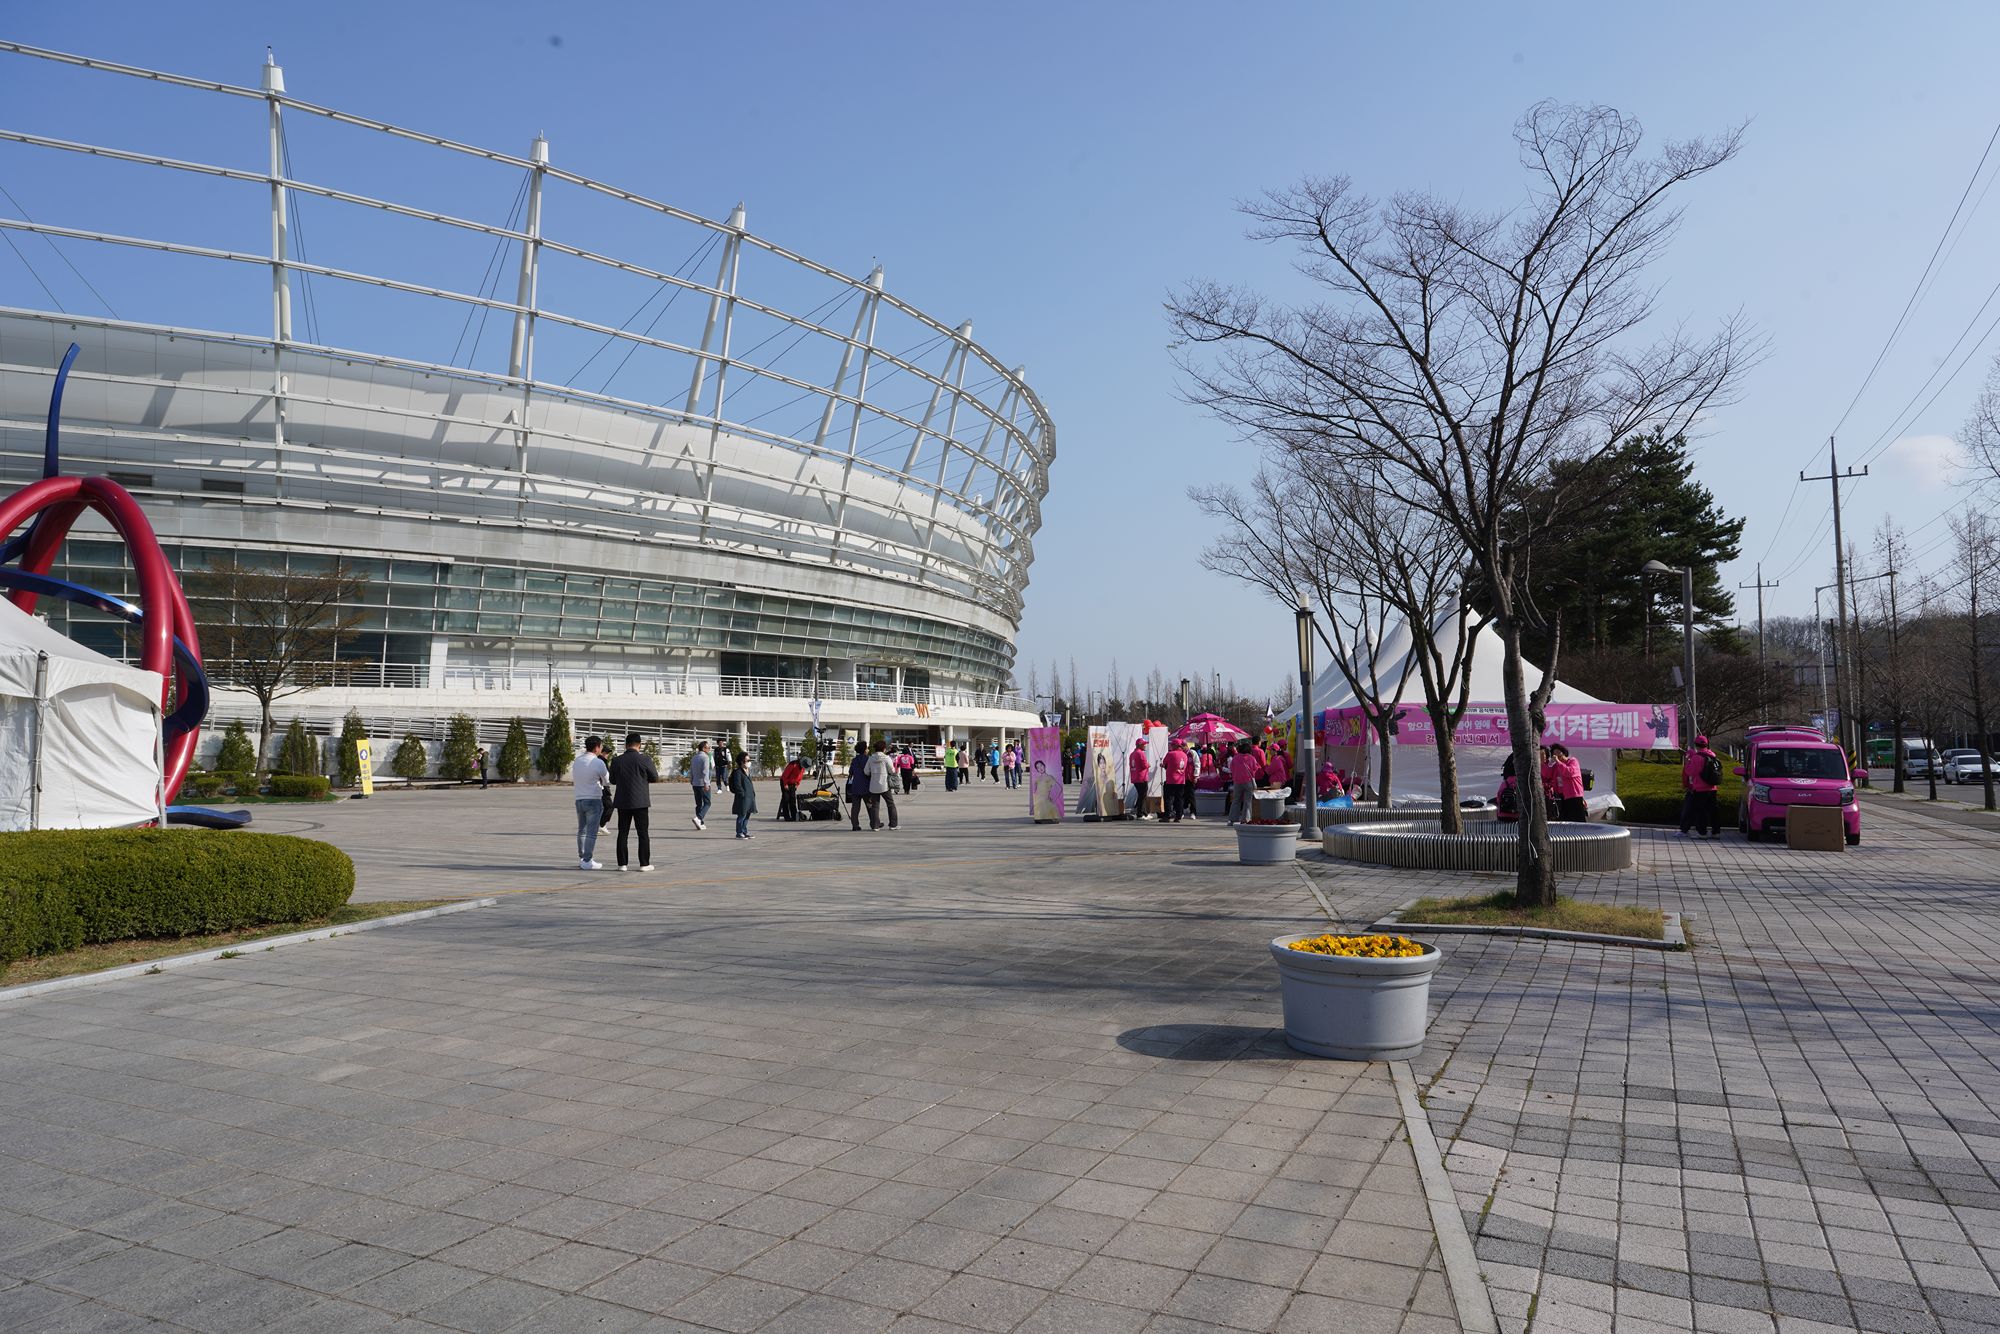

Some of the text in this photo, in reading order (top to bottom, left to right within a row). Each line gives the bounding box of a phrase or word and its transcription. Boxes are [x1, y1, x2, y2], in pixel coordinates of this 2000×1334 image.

[1407, 721, 1431, 732] 앞으로
[1474, 720, 1491, 730] 옆에
[1544, 711, 1640, 742] 지켜줄께!
